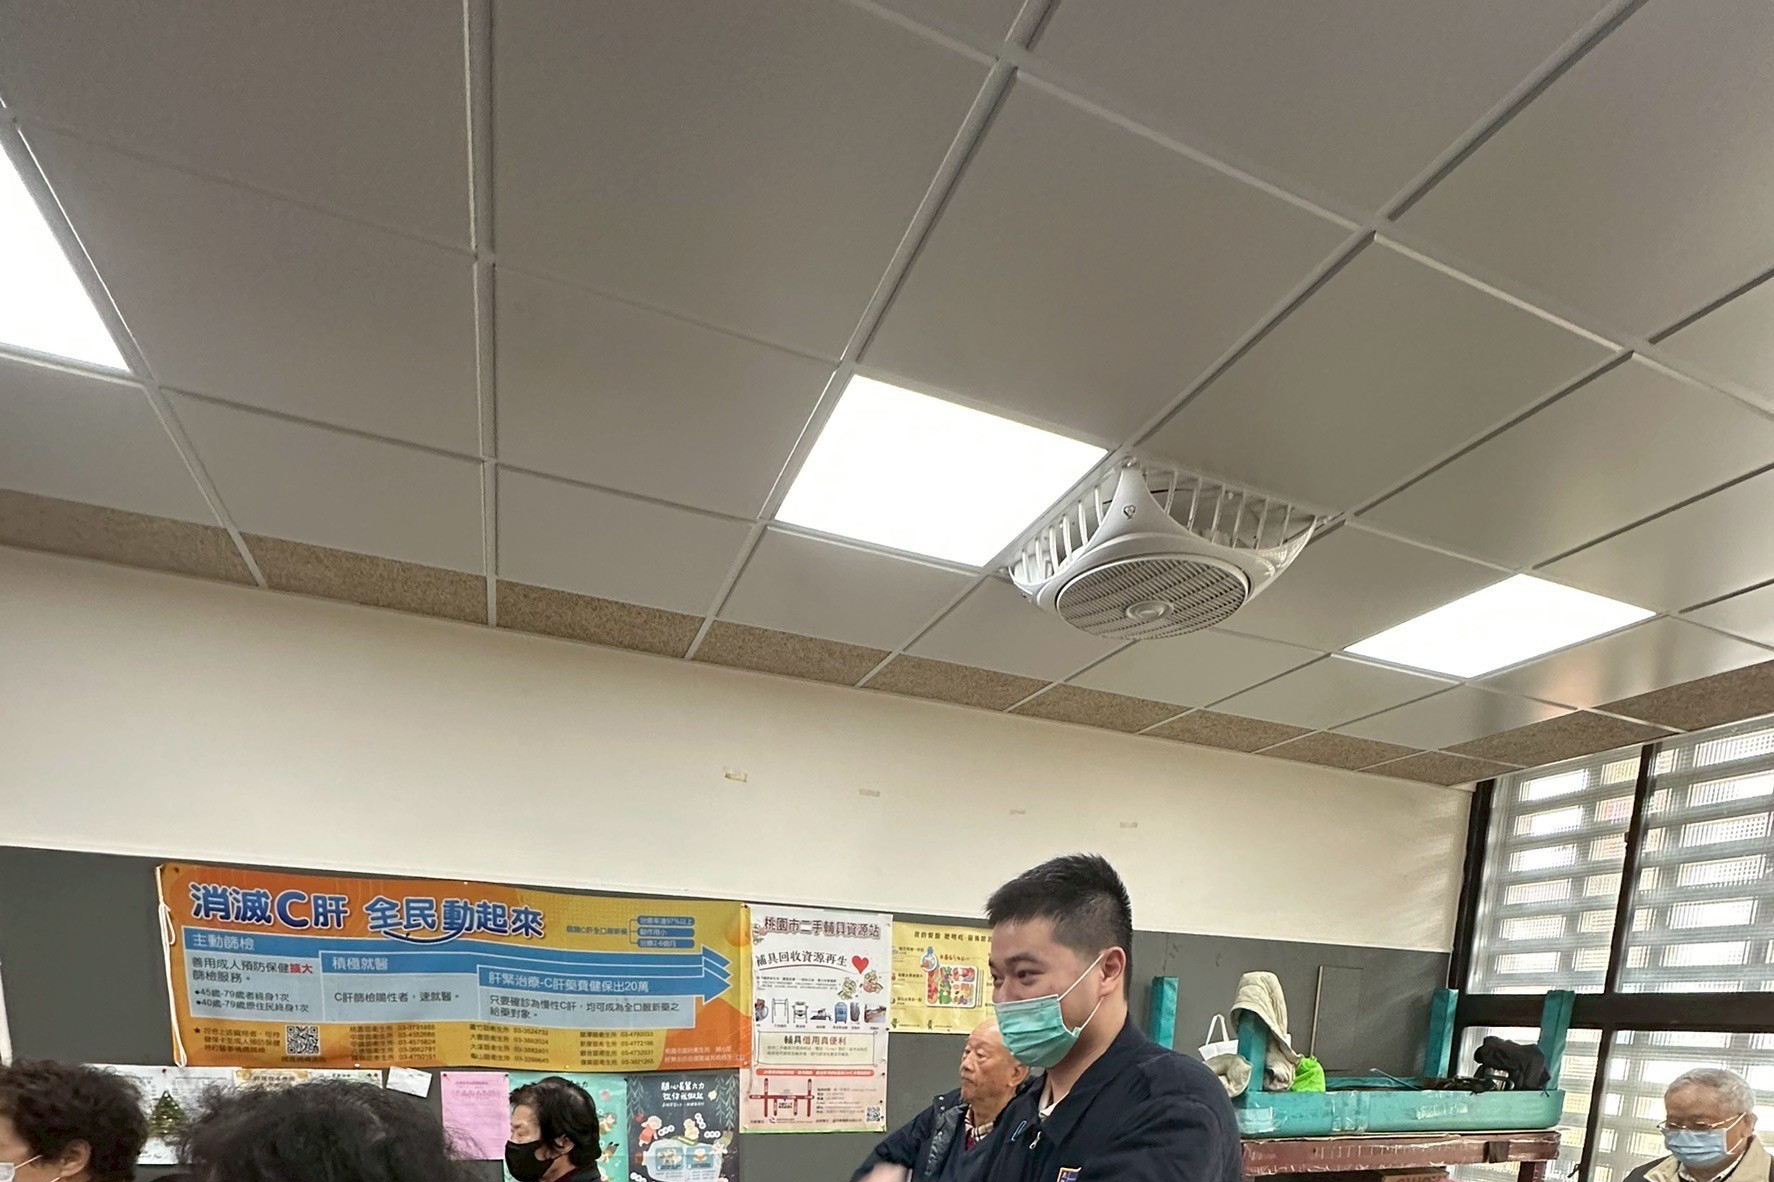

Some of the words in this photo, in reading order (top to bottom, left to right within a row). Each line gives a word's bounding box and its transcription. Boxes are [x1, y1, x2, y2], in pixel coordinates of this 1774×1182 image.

[189, 882, 349, 929] 消滅C肝
[363, 896, 545, 938] 全民動起來
[765, 916, 881, 939] 桃園市二手輔具資源站
[192, 933, 255, 951] 主動篩檢
[332, 956, 388, 971] 積極就醫
[488, 971, 649, 993] 肝緊治療-C肝藥費健保出20萬
